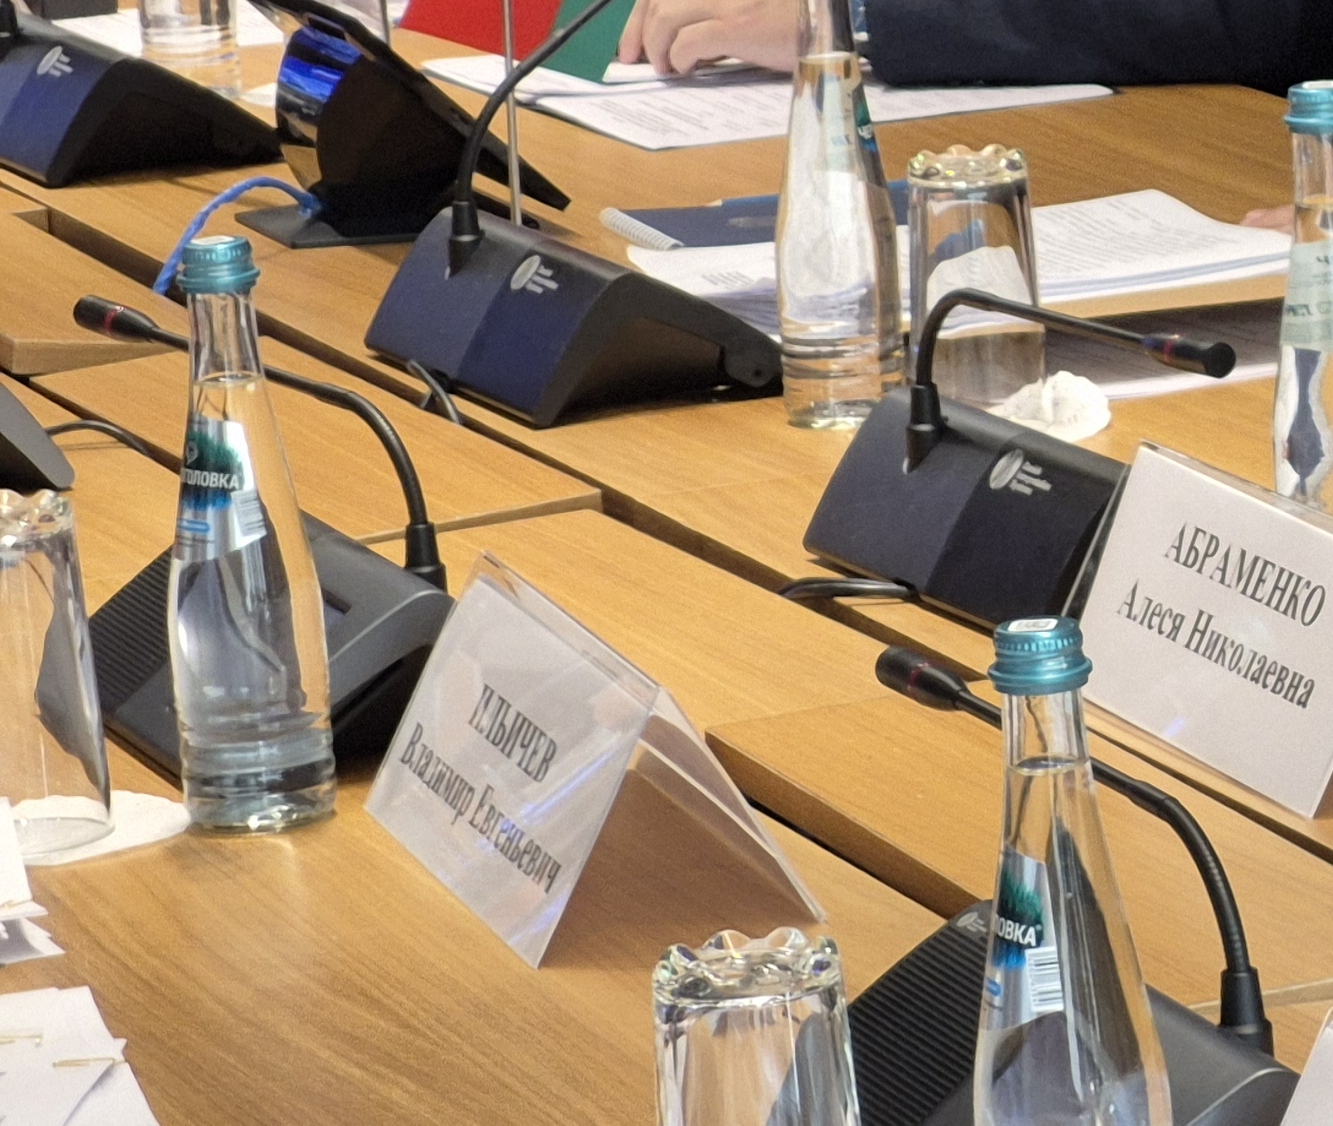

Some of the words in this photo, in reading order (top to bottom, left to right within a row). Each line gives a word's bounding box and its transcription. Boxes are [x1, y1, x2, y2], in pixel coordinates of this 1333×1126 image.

[1164, 522, 1326, 626] АБРАМЕНКО
[1117, 579, 1186, 642] Алеся
[1185, 609, 1315, 708] Николаевна
[468, 684, 557, 783] ИЛЬИЧЕВ
[400, 722, 475, 824] Владимир
[468, 784, 562, 894] Евгеньевич
